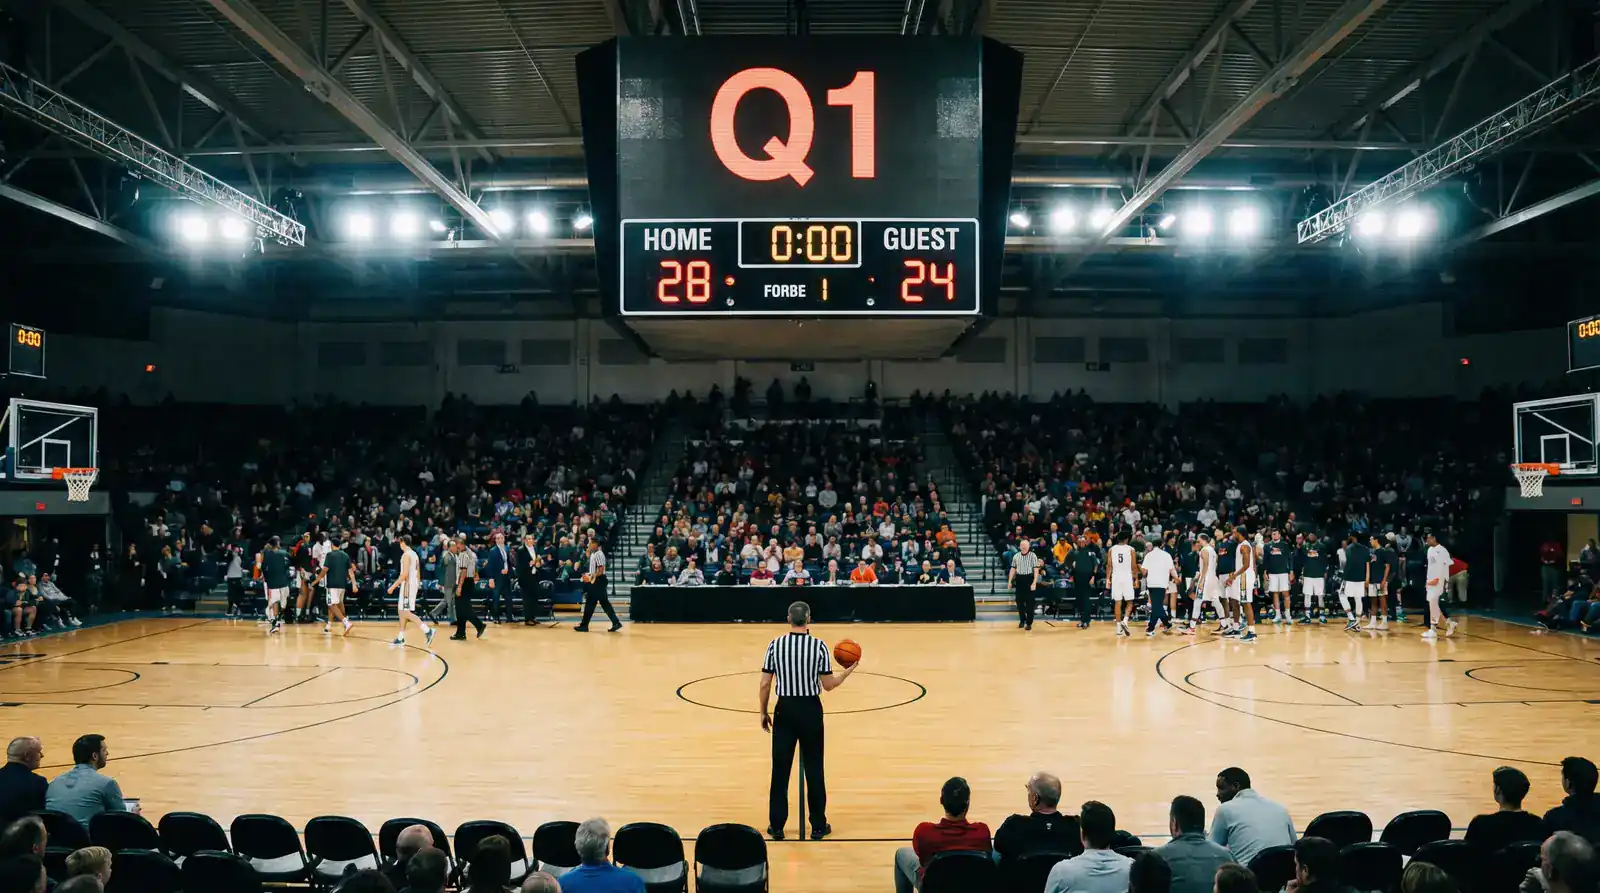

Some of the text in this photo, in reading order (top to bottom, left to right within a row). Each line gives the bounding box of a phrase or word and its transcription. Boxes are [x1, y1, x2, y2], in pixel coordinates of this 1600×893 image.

[710, 67, 875, 187] Q1
[644, 228, 712, 250] HOME
[771, 225, 851, 261] 0:00
[883, 227, 960, 250] GUEST
[658, 261, 710, 303] 28
[764, 278, 828, 301] FORBE 1
[902, 260, 954, 302] 24
[18, 329, 41, 347] 0:00
[1579, 320, 1600, 337] 0:00
